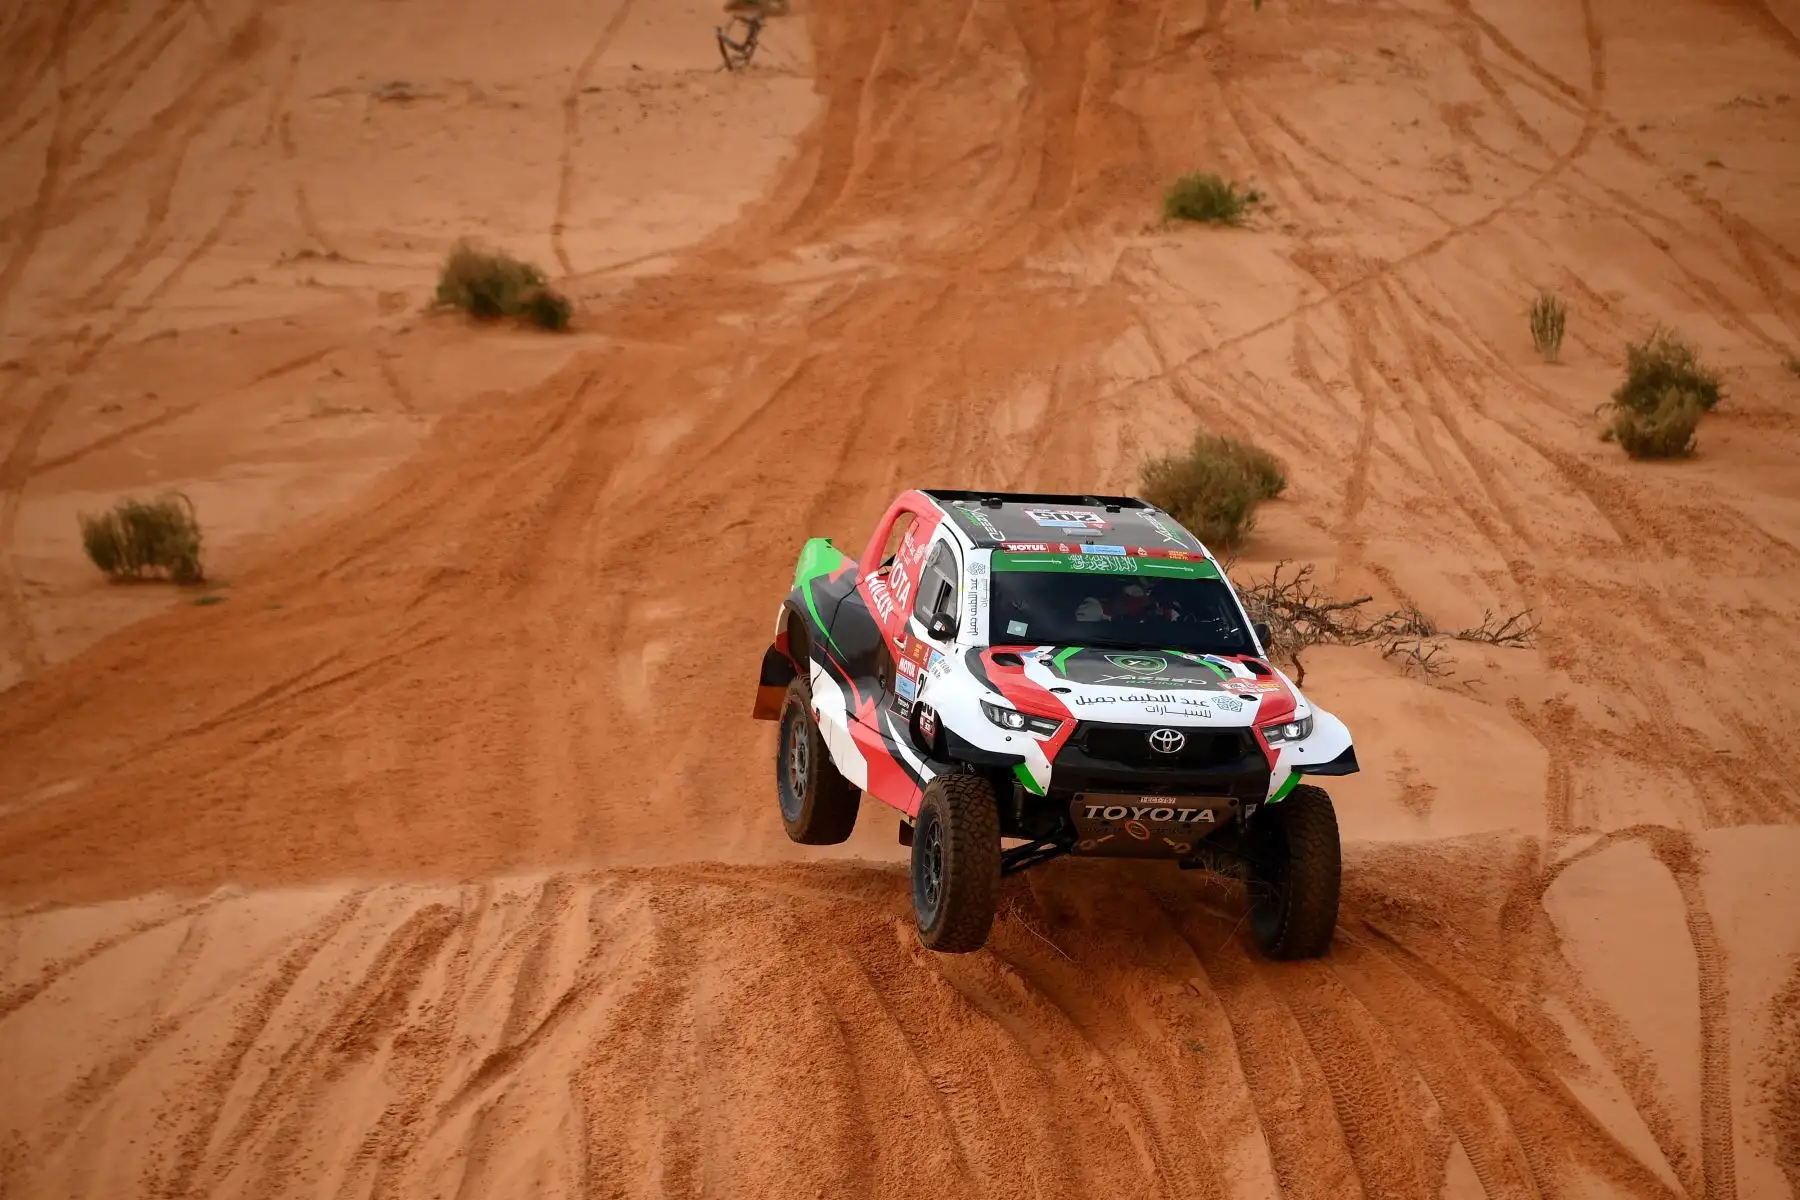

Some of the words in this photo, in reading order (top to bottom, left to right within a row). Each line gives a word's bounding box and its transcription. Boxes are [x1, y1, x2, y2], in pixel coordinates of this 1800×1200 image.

[865, 570, 894, 624] HILUX
[1075, 694, 1116, 706] جميل
[1119, 693, 1176, 703] اللطيف
[1180, 696, 1210, 707] عبد
[1084, 805, 1216, 823] TOYOTA
